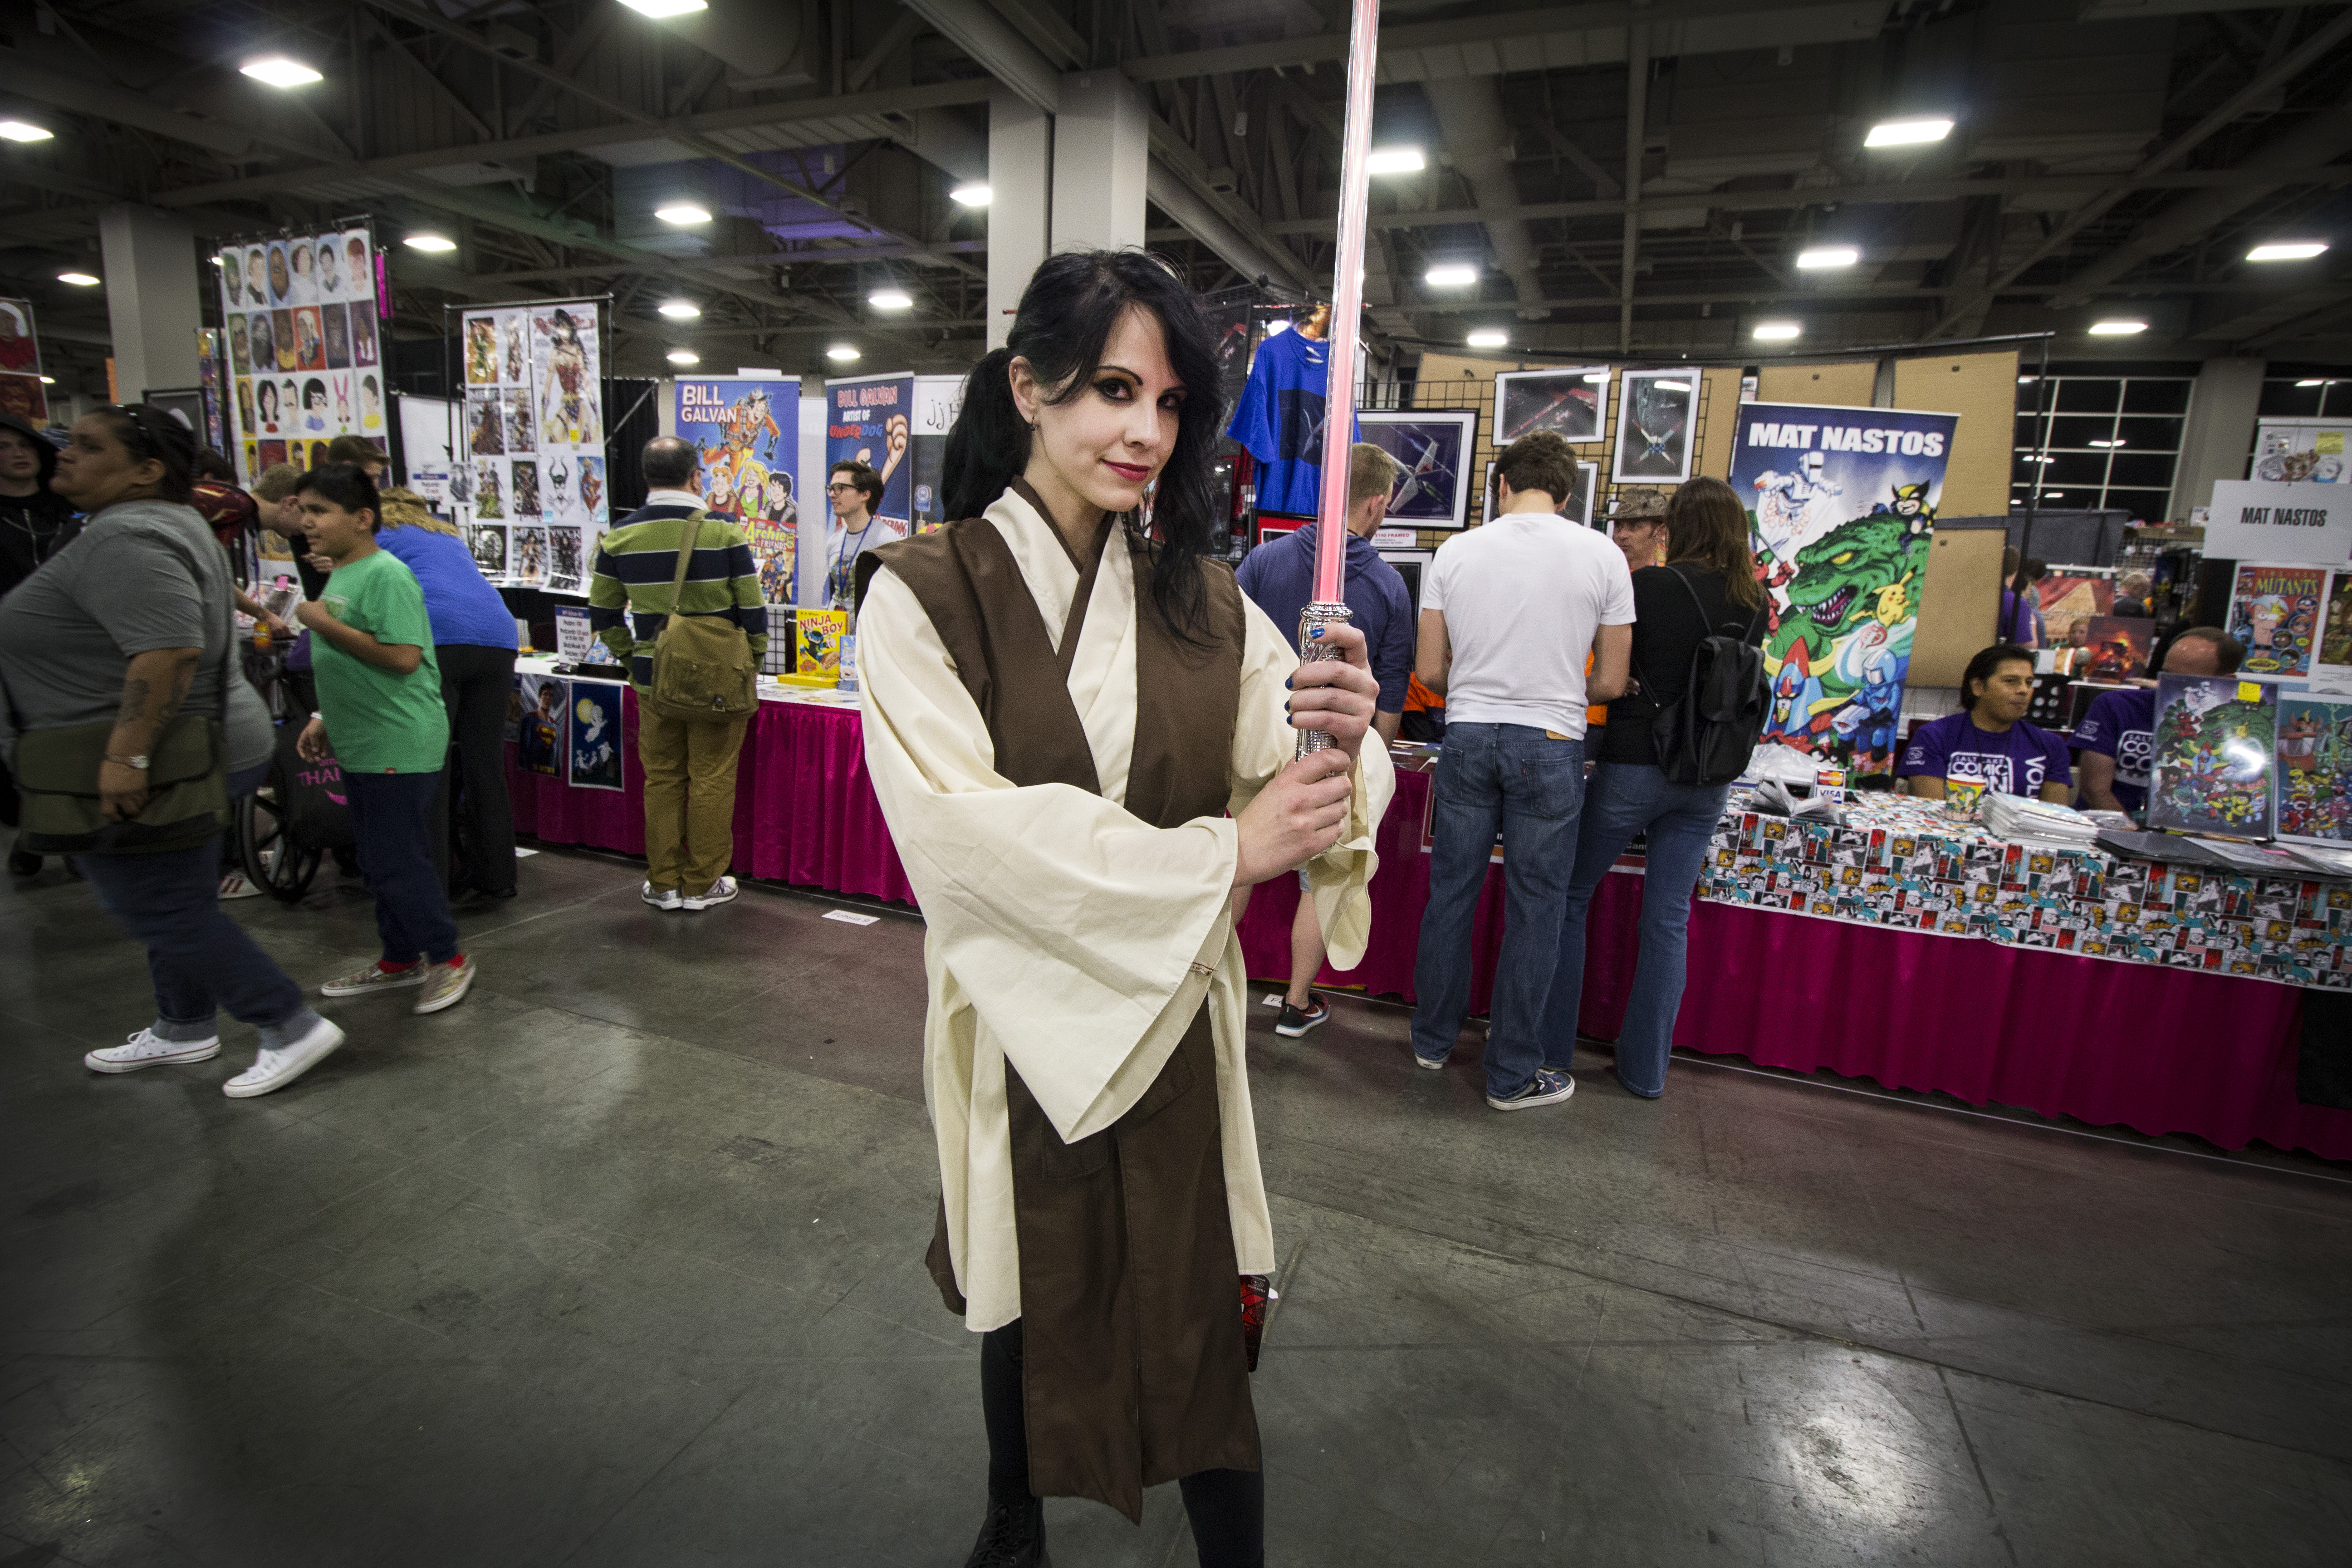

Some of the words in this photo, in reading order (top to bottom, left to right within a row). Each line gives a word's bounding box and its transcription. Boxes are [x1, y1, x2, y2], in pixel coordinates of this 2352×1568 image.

[682, 384, 725, 406] BILL
[838, 389, 858, 407] BILL
[860, 386, 897, 407] GALVAN
[681, 407, 737, 423] GALVAN
[843, 410, 861, 422] ARTIST
[862, 409, 870, 421] OF
[1748, 422, 1818, 449] MAT
[1821, 426, 1945, 457] NASTOS
[2240, 507, 2271, 524] MAT
[2273, 508, 2328, 527] NASTOS
[745, 520, 786, 544] Archie
[761, 539, 786, 550] FRIENDS
[2255, 577, 2319, 596] MUTANTS
[799, 614, 832, 630] NINJA
[822, 622, 843, 636] BOY
[1248, 1284, 1265, 1293] SUBARU
